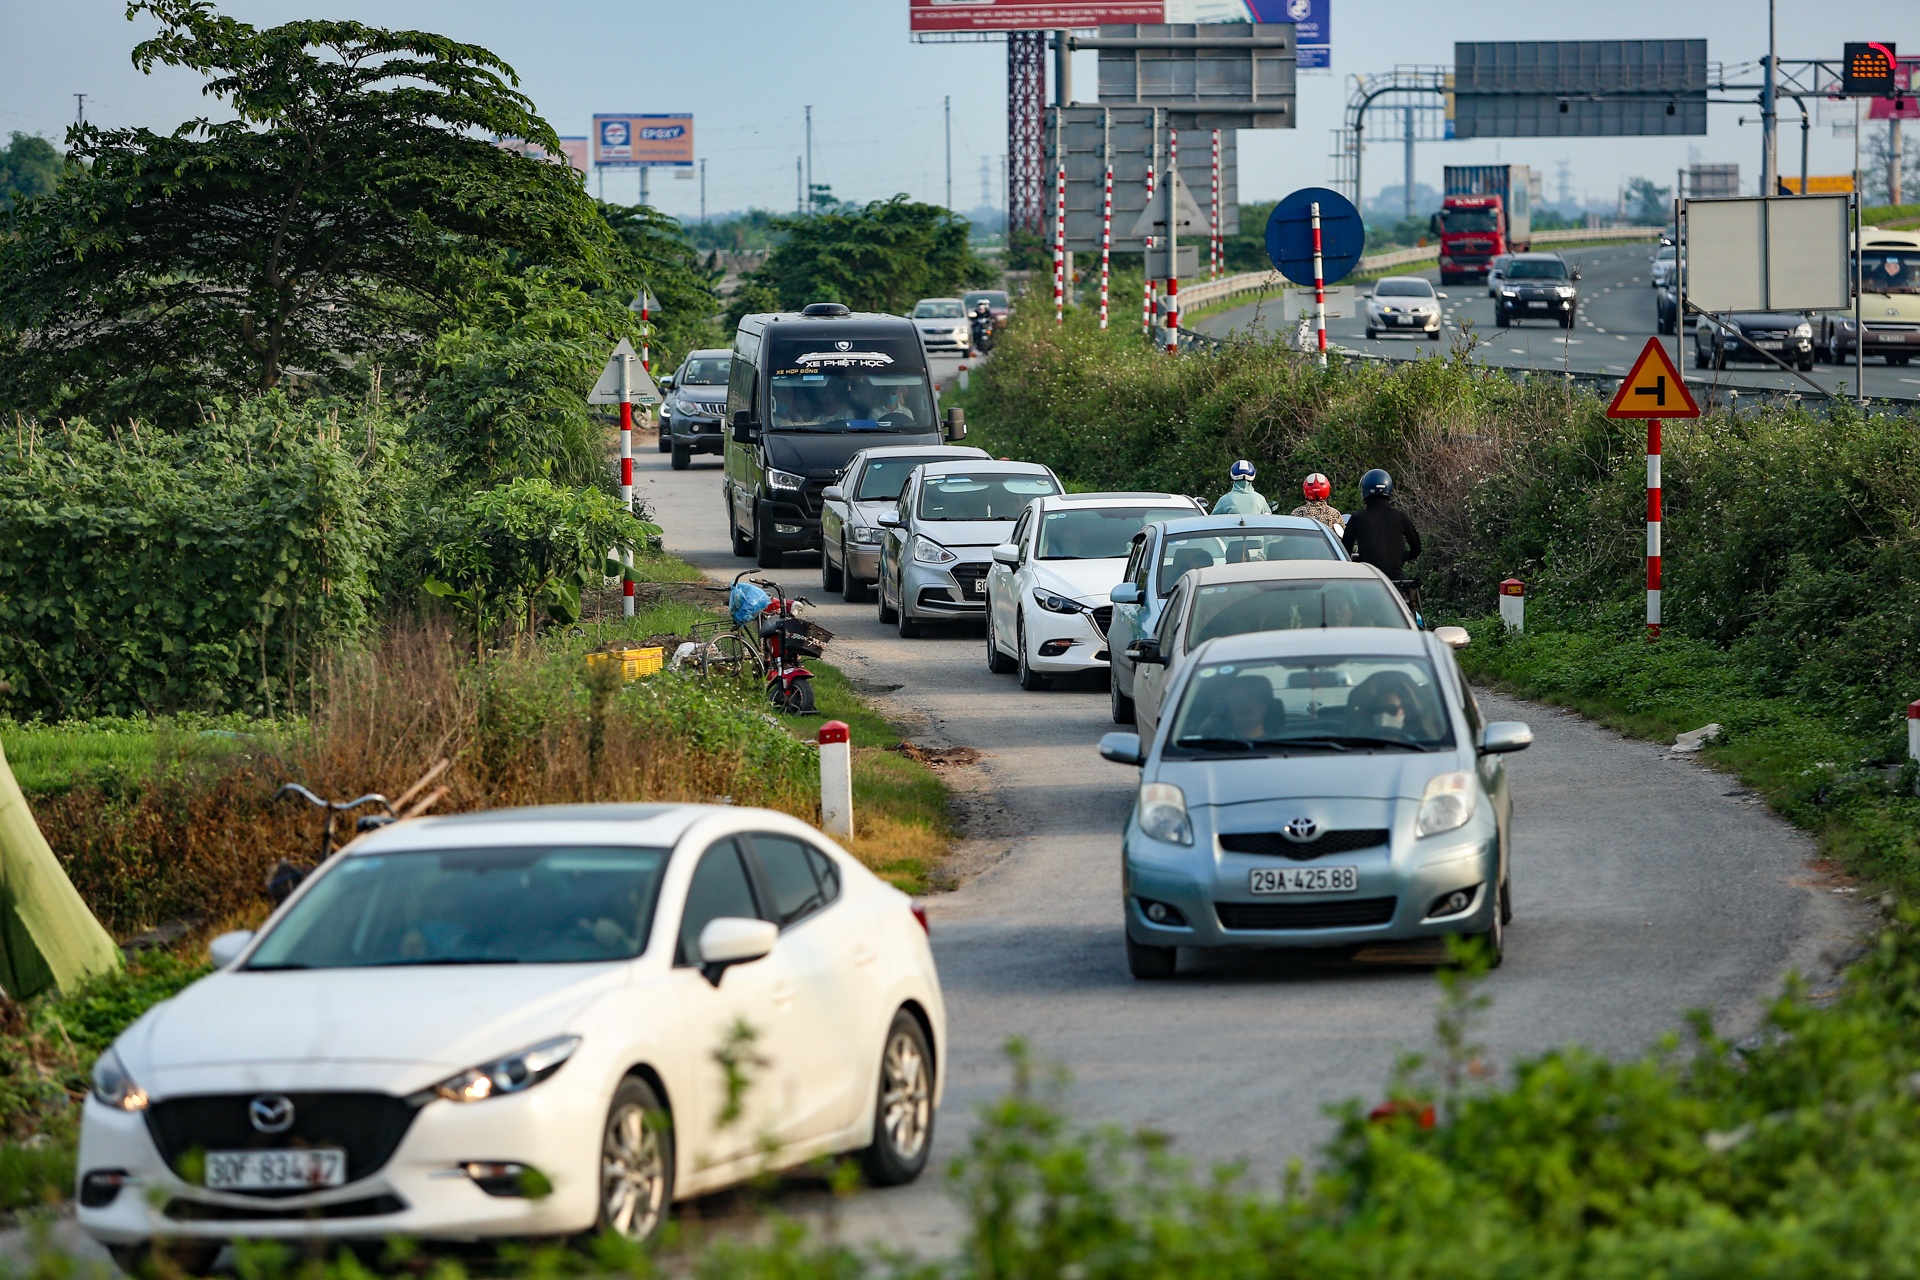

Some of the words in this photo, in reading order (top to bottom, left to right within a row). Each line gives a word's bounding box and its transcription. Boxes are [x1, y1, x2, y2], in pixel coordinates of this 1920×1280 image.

[643, 127, 681, 140] EPOXY
[806, 360, 821, 368] XE
[860, 360, 884, 368] HỌC
